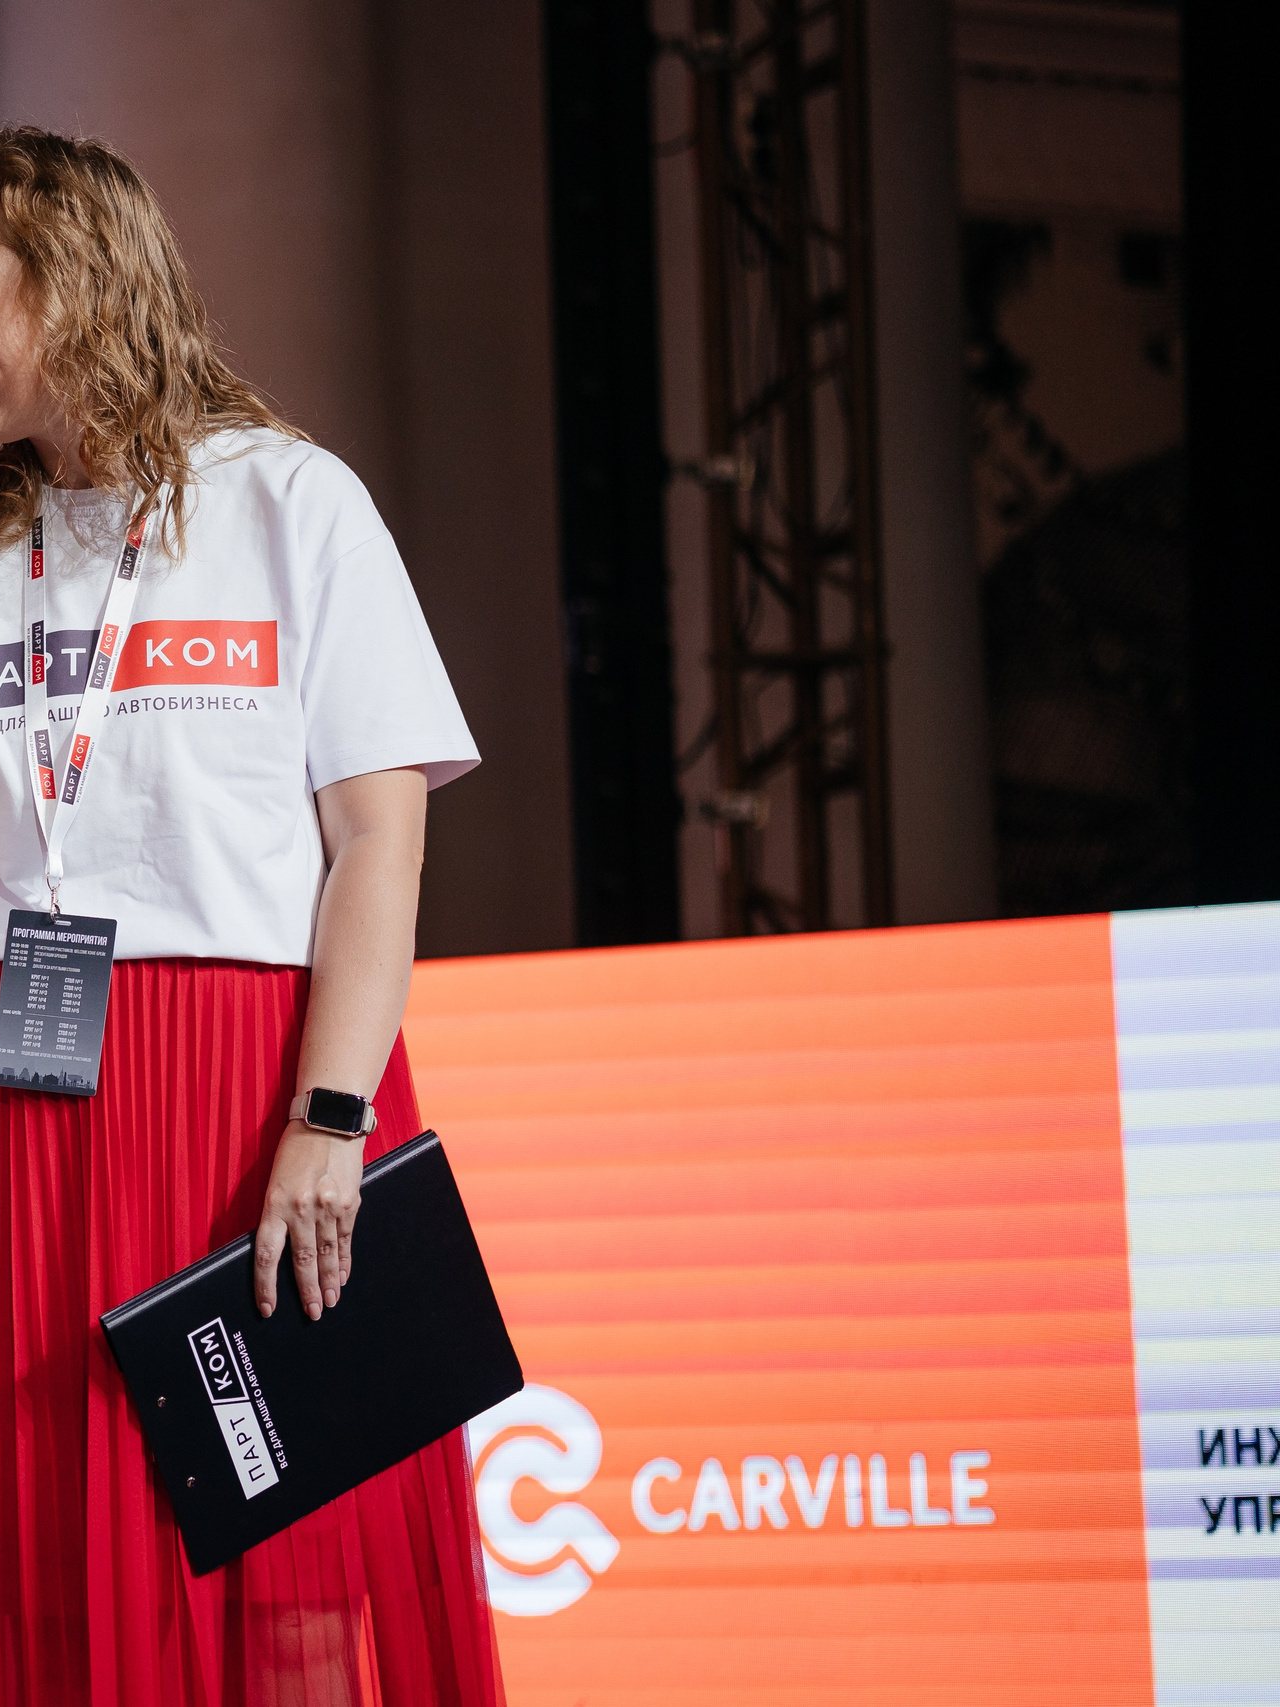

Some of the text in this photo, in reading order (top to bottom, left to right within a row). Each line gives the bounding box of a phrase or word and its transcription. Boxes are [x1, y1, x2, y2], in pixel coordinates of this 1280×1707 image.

[122, 550, 135, 576] ПАРТ
[94, 627, 115, 685] ПАРТ КОМ
[145, 637, 259, 669] КОМ
[117, 696, 258, 715] АВТОБИЗНЕСА
[38, 734, 52, 796] ПАРТ КОМ
[65, 738, 86, 799] ПАРТ КОМ
[84, 741, 95, 769] АВТОБИЗНЕСА
[12, 927, 107, 946] ПРОГРАММА МЕРОПРИЯТИЯ
[200, 1331, 266, 1483] ПАРТ КОМ
[268, 1429, 284, 1449] ДЛЯ
[275, 1450, 288, 1469] ВСЕ
[630, 1448, 997, 1535] CARVILLE
